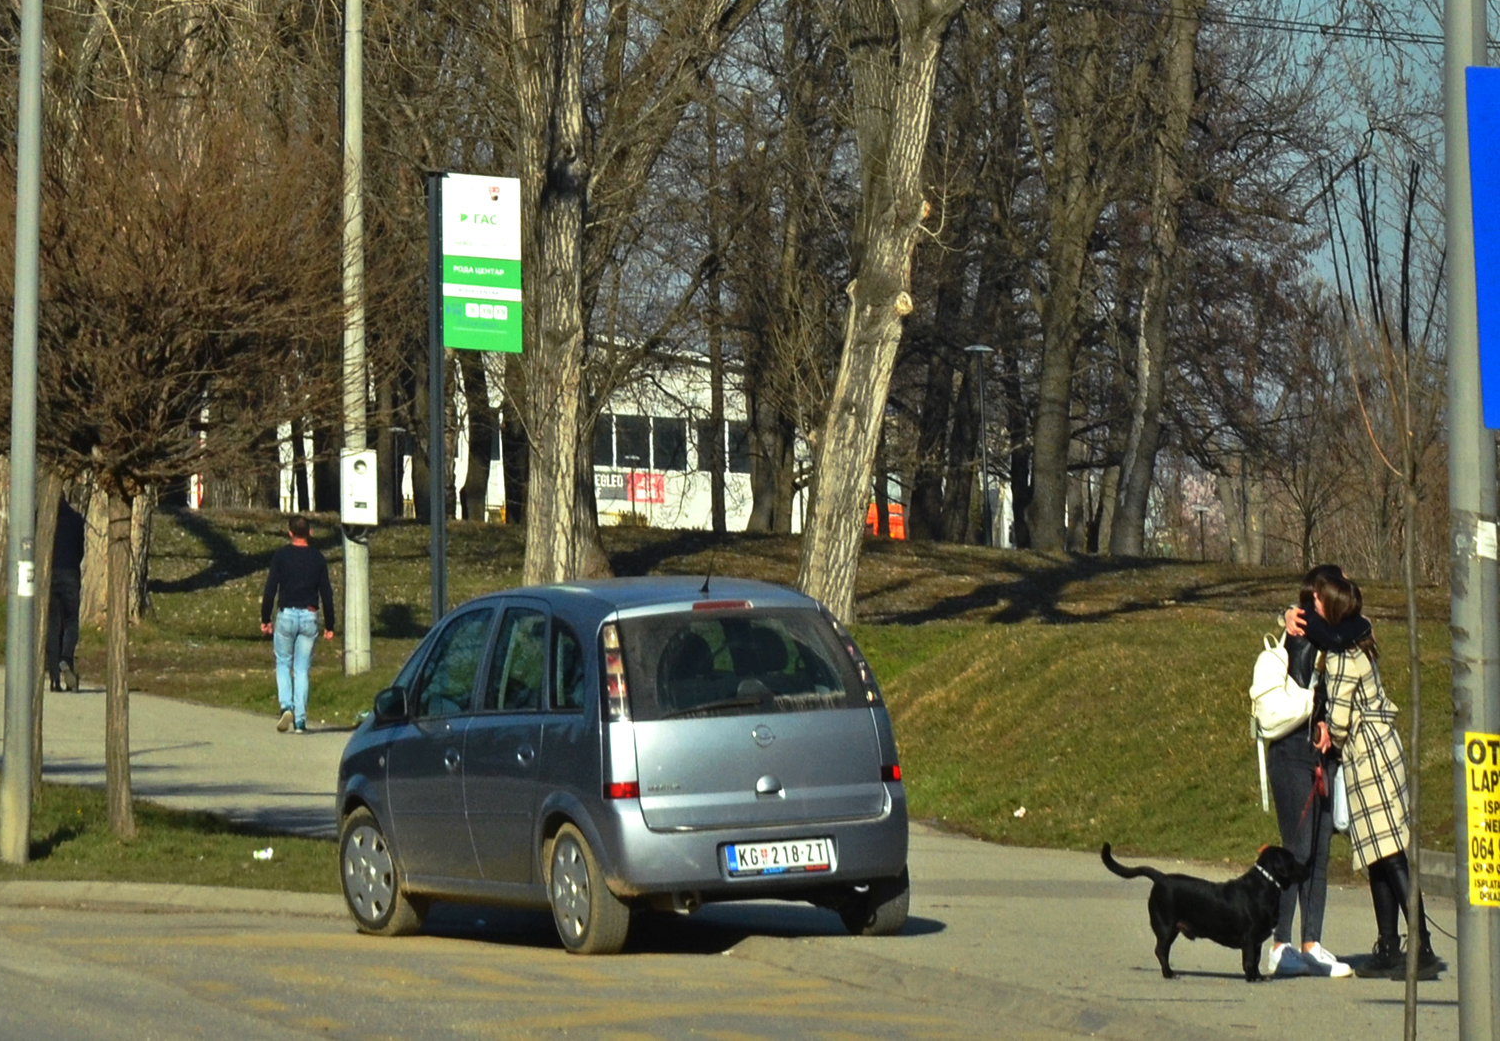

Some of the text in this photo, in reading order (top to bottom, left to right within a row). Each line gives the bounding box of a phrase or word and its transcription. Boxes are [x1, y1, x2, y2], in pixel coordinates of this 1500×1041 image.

[1471, 768, 1500, 793] LAP
[1484, 819, 1500, 833] NE
[738, 847, 759, 867] KG
[1472, 836, 1494, 860] 064
